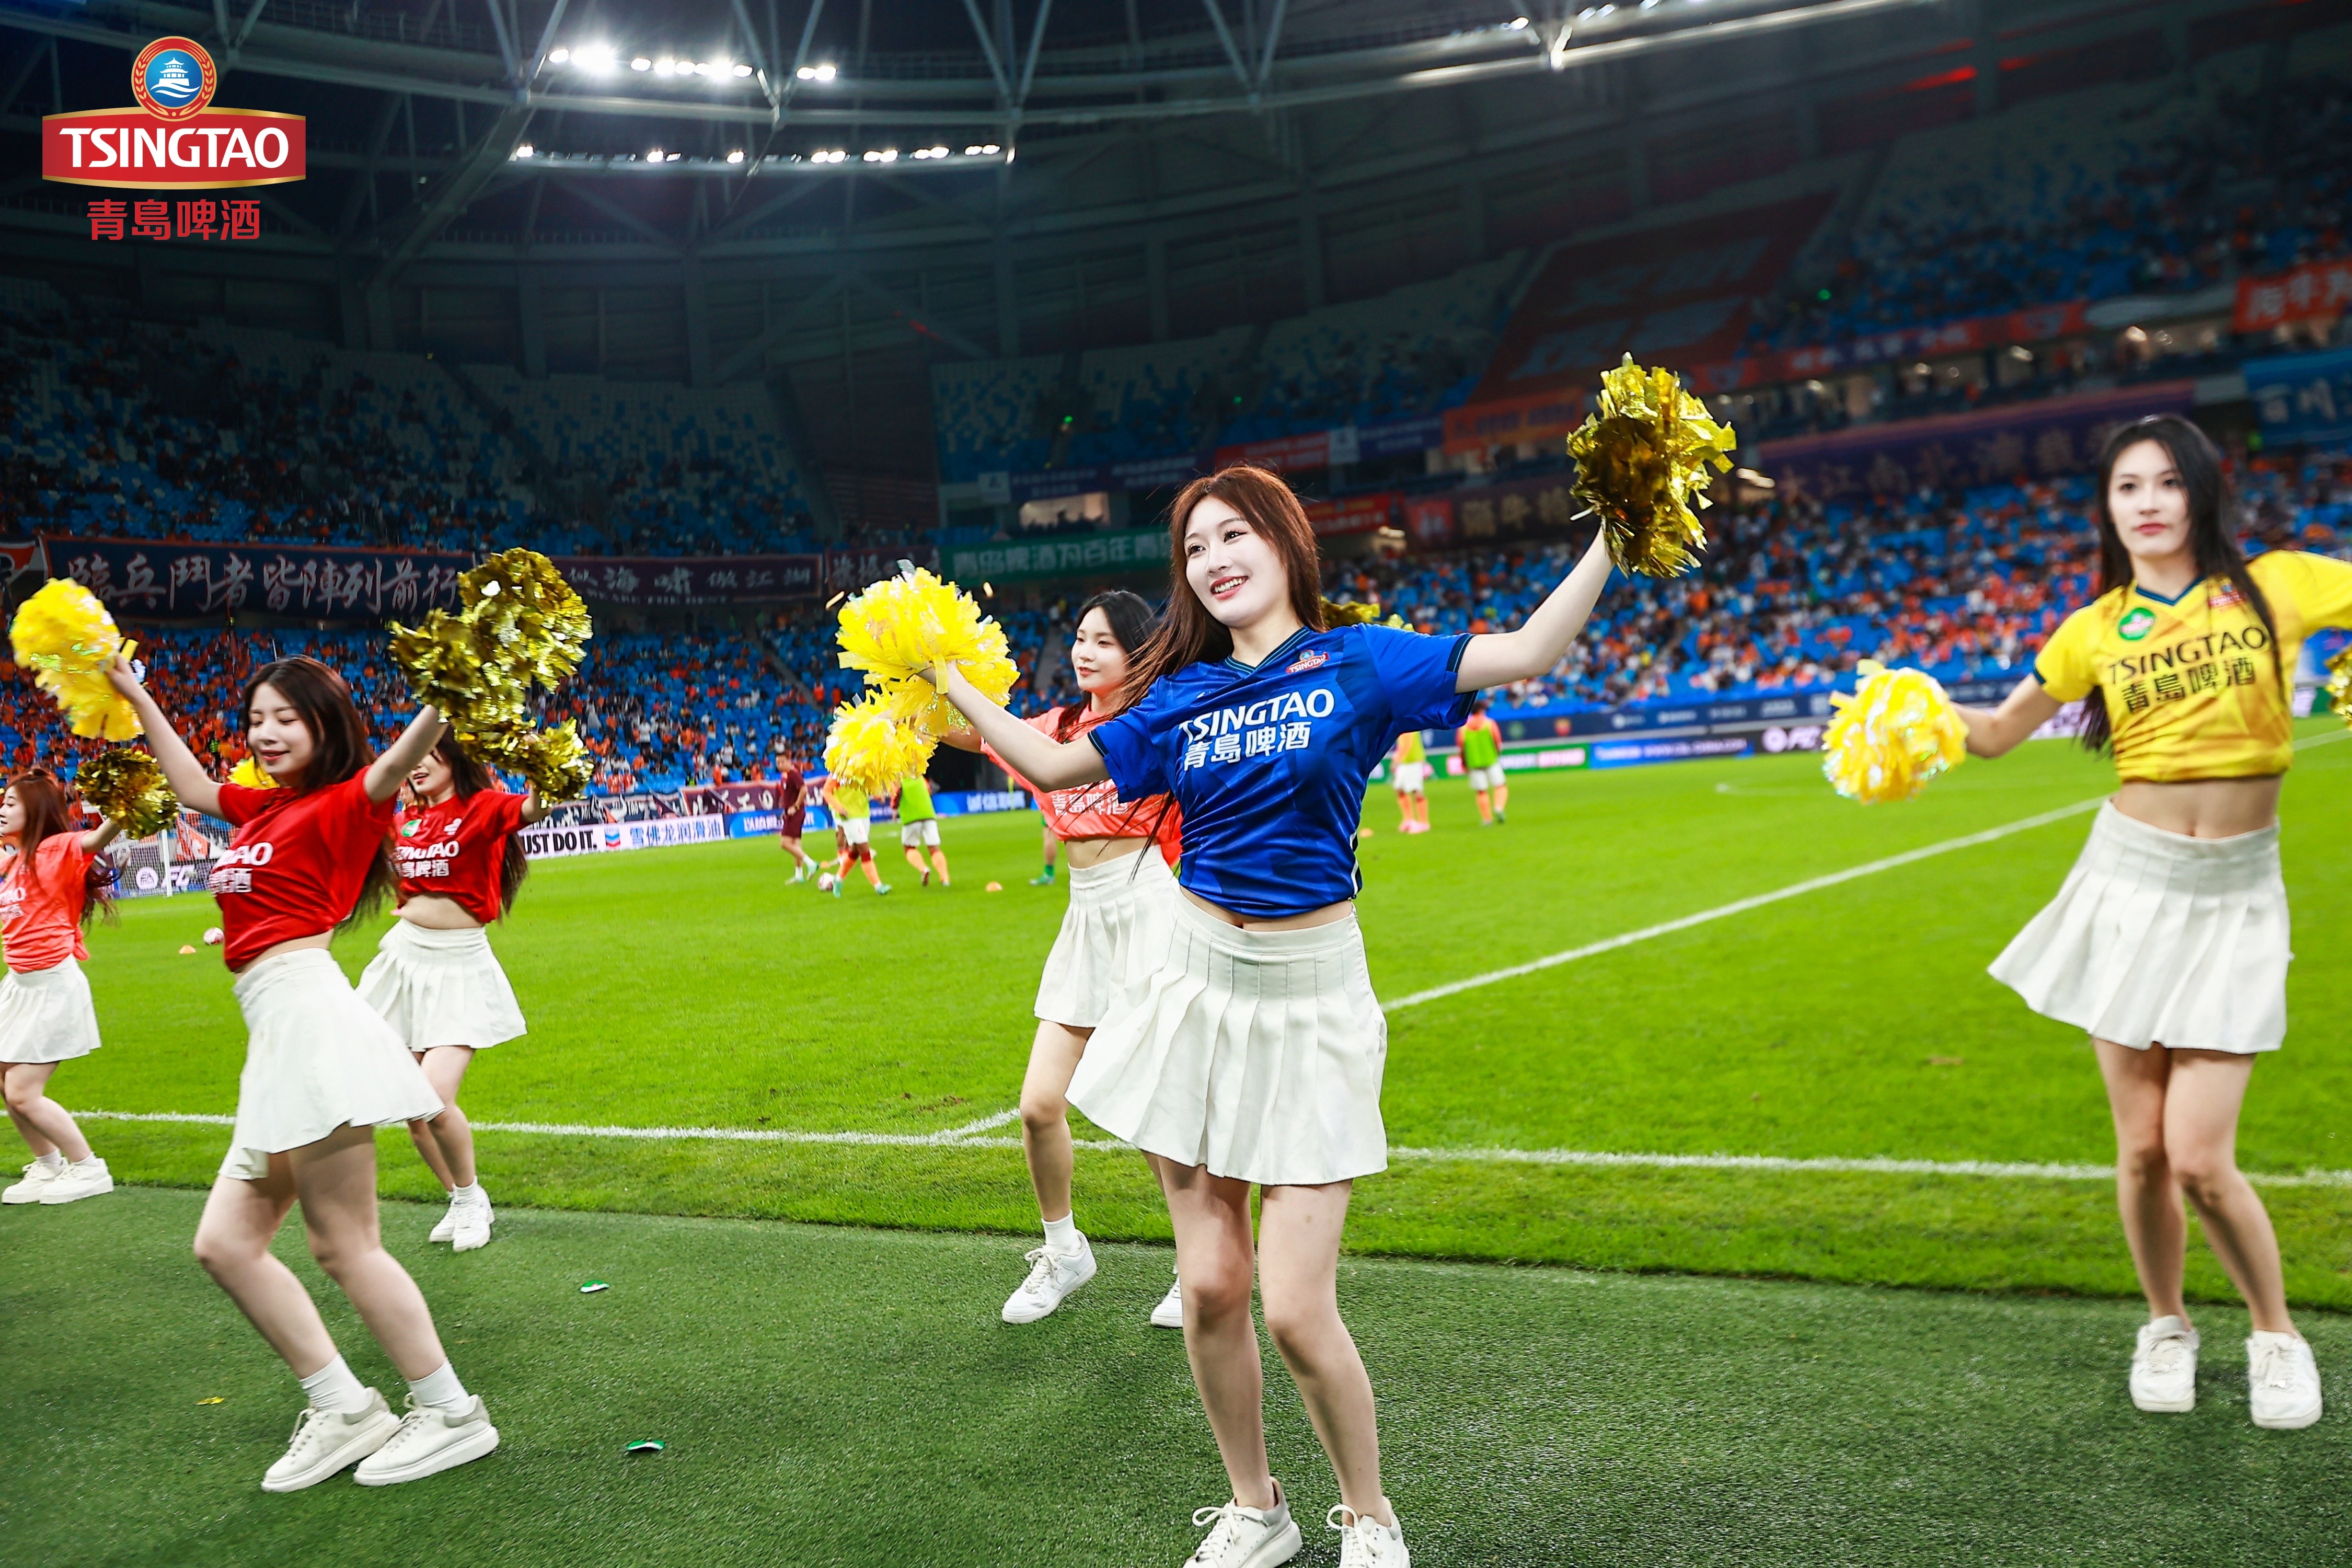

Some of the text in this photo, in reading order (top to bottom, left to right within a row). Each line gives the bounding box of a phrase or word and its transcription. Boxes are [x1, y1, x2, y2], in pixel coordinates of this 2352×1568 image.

[1288, 653, 1326, 673] TSINGTAO
[2109, 627, 2267, 685] TSINGTAO
[2121, 656, 2255, 714] 青島啤酒
[1178, 688, 1335, 745] TSINGTAO
[1183, 721, 1312, 771] 青島啤酒
[519, 829, 597, 855] UST DO IT.
